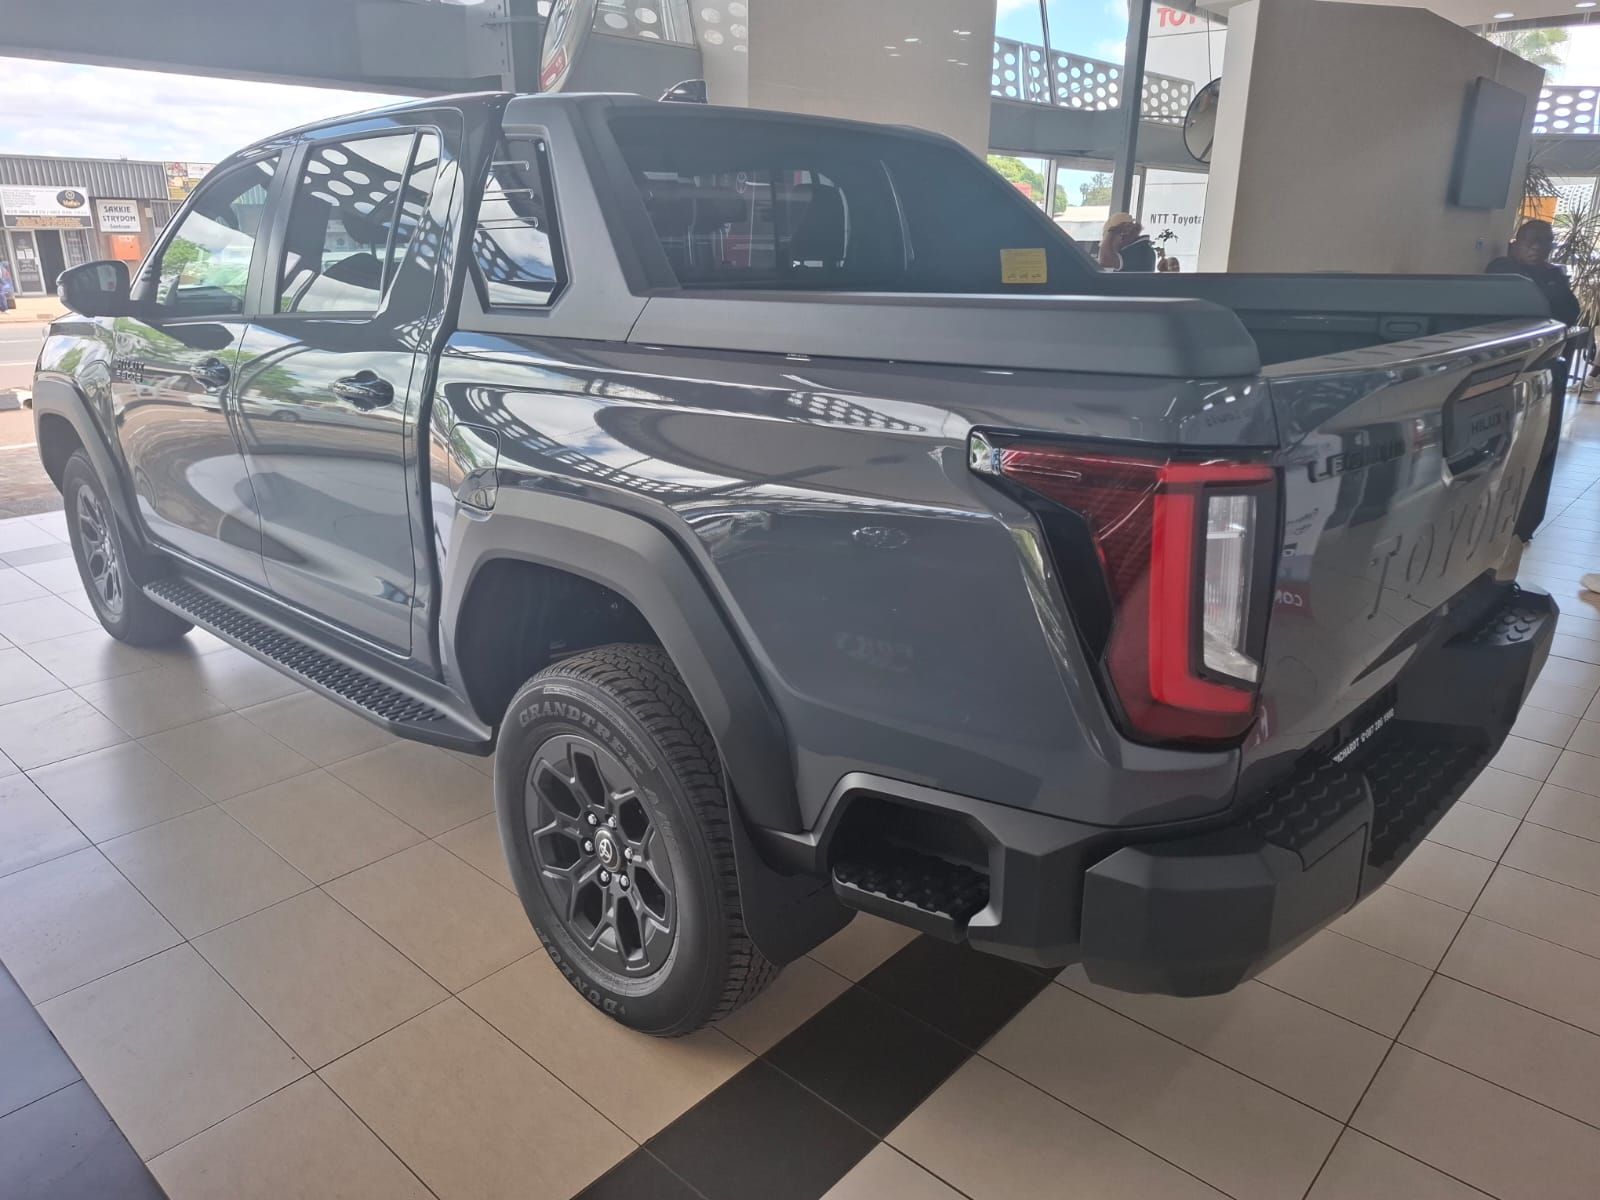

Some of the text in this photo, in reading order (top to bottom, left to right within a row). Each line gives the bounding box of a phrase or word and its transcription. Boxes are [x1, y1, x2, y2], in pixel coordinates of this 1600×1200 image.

[1150, 213, 1169, 225] NTT
[1367, 466, 1527, 621] TOYOTA
[517, 700, 645, 777] GRANDTREK
